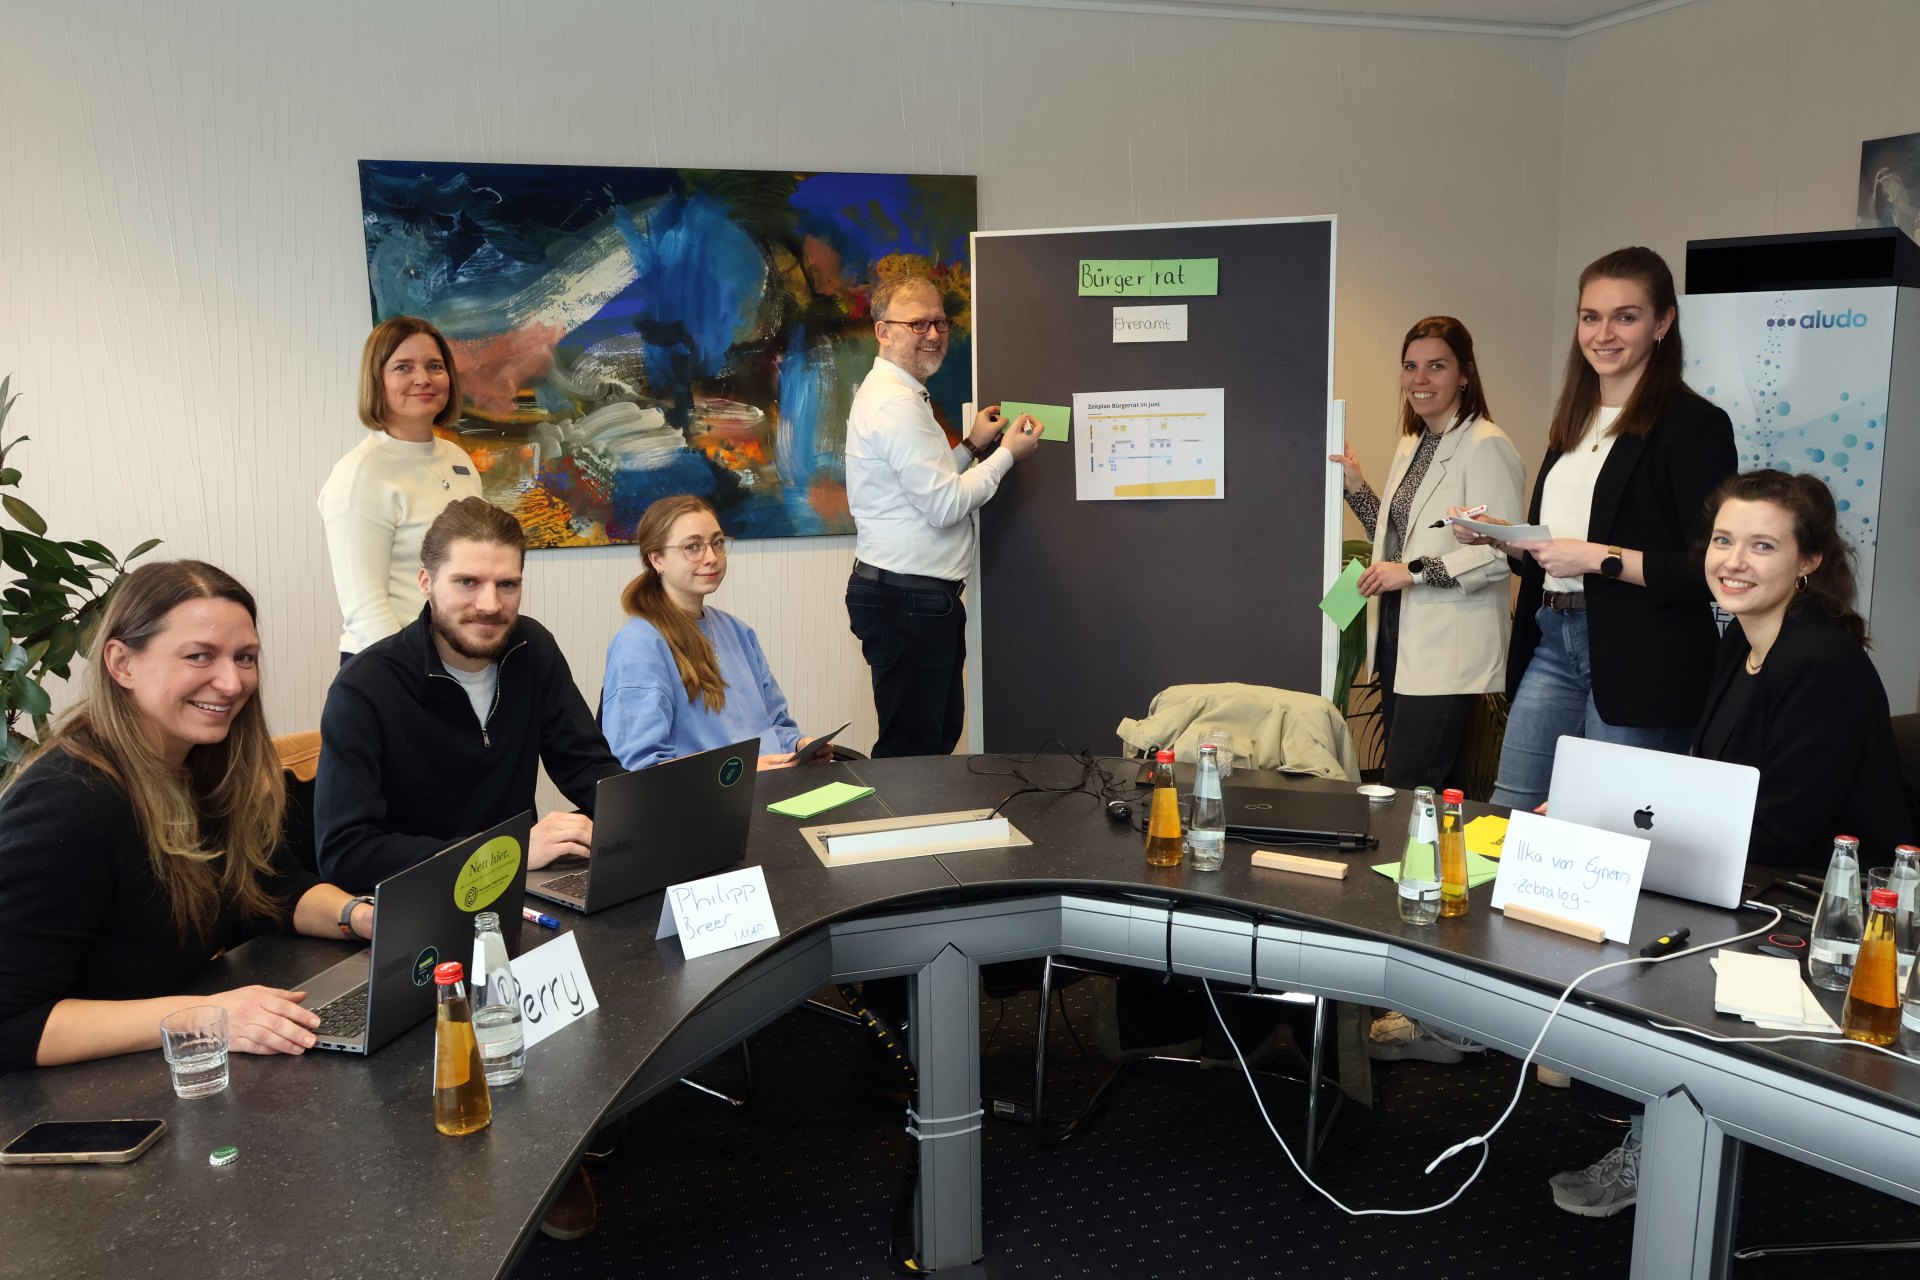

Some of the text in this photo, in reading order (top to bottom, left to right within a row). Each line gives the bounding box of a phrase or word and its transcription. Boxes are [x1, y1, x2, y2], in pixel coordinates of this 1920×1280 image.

[1114, 317, 1171, 331] Ehrenamt
[1799, 308, 1868, 329] aludo
[470, 860, 488, 877] Nett
[491, 850, 509, 866] hier.
[1552, 856, 1574, 871] von
[672, 882, 756, 913] Philipp
[682, 913, 732, 940] Breer
